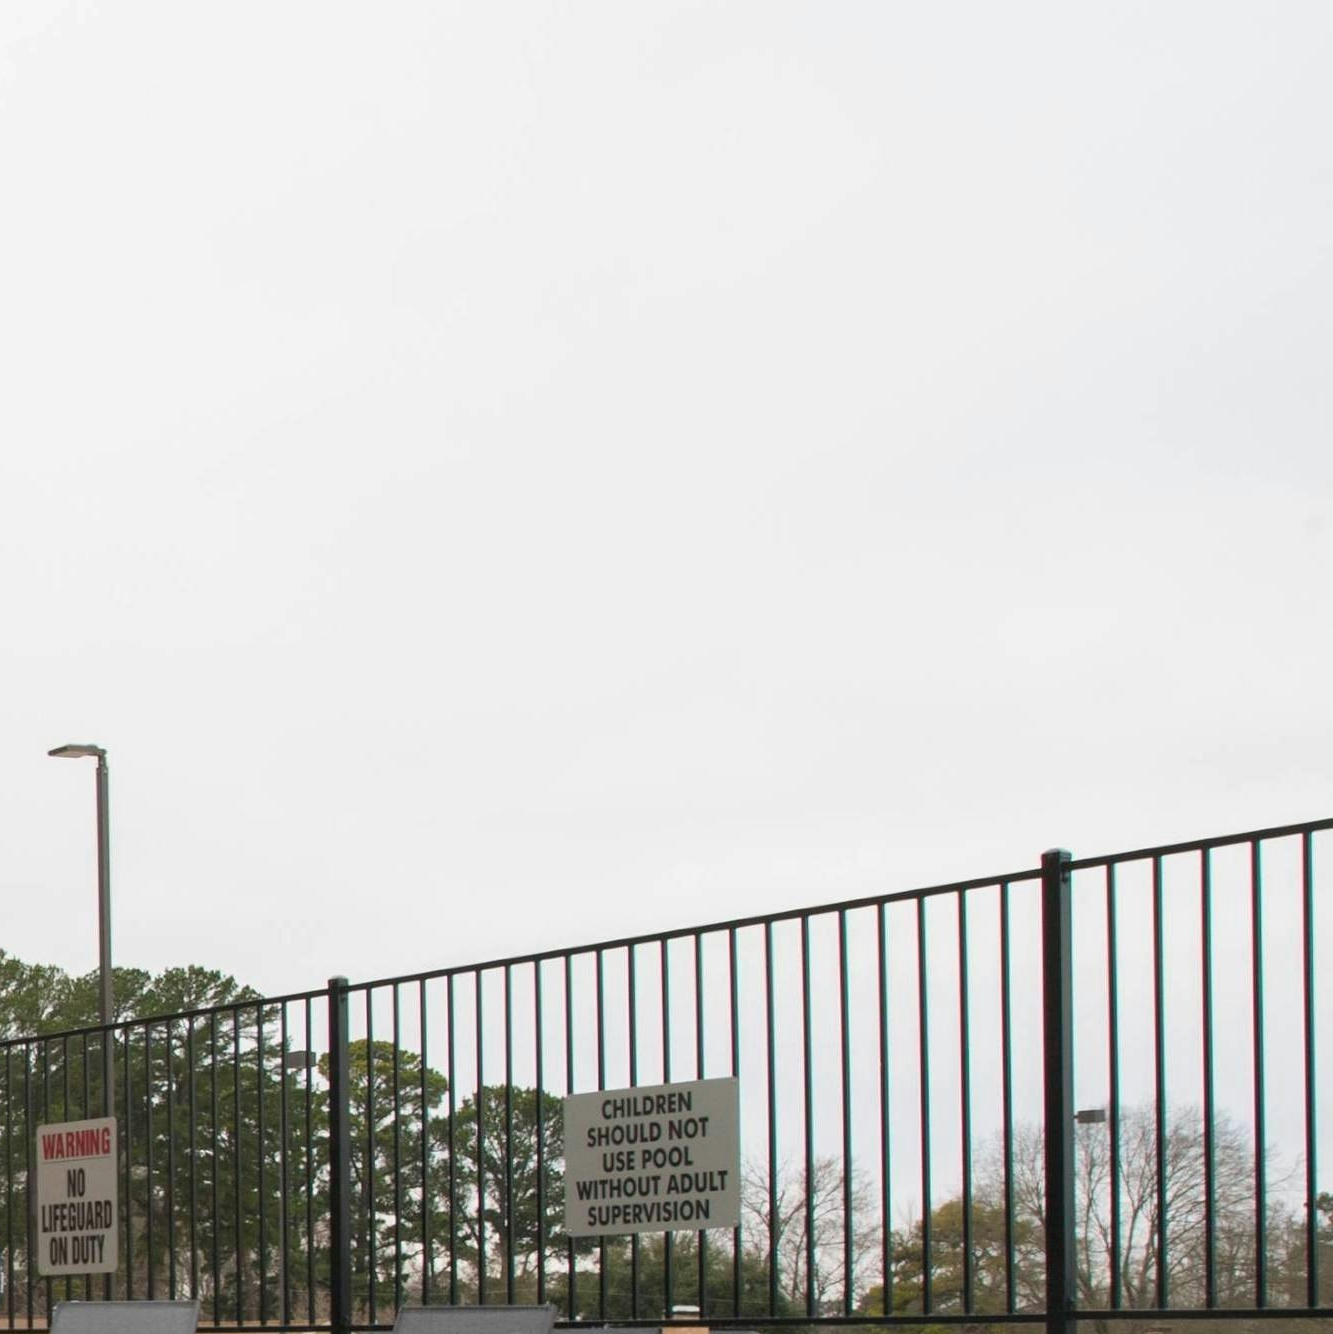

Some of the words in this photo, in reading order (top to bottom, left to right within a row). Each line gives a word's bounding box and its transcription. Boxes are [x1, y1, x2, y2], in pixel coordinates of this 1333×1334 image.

[601, 1091, 693, 1120] CHILDREN
[42, 1127, 111, 1160] WARNING
[587, 1121, 662, 1148] SHOULD
[668, 1116, 709, 1141] NOT
[602, 1150, 635, 1173] USE
[642, 1146, 693, 1170] POOL
[67, 1168, 86, 1198] NO
[576, 1175, 661, 1201] WITHOUT
[667, 1170, 728, 1195] ADULT
[41, 1200, 112, 1233] LIFEGUARD
[588, 1199, 710, 1227] SUPERVISION
[49, 1236, 68, 1266] ON
[72, 1234, 106, 1265] DUTY
